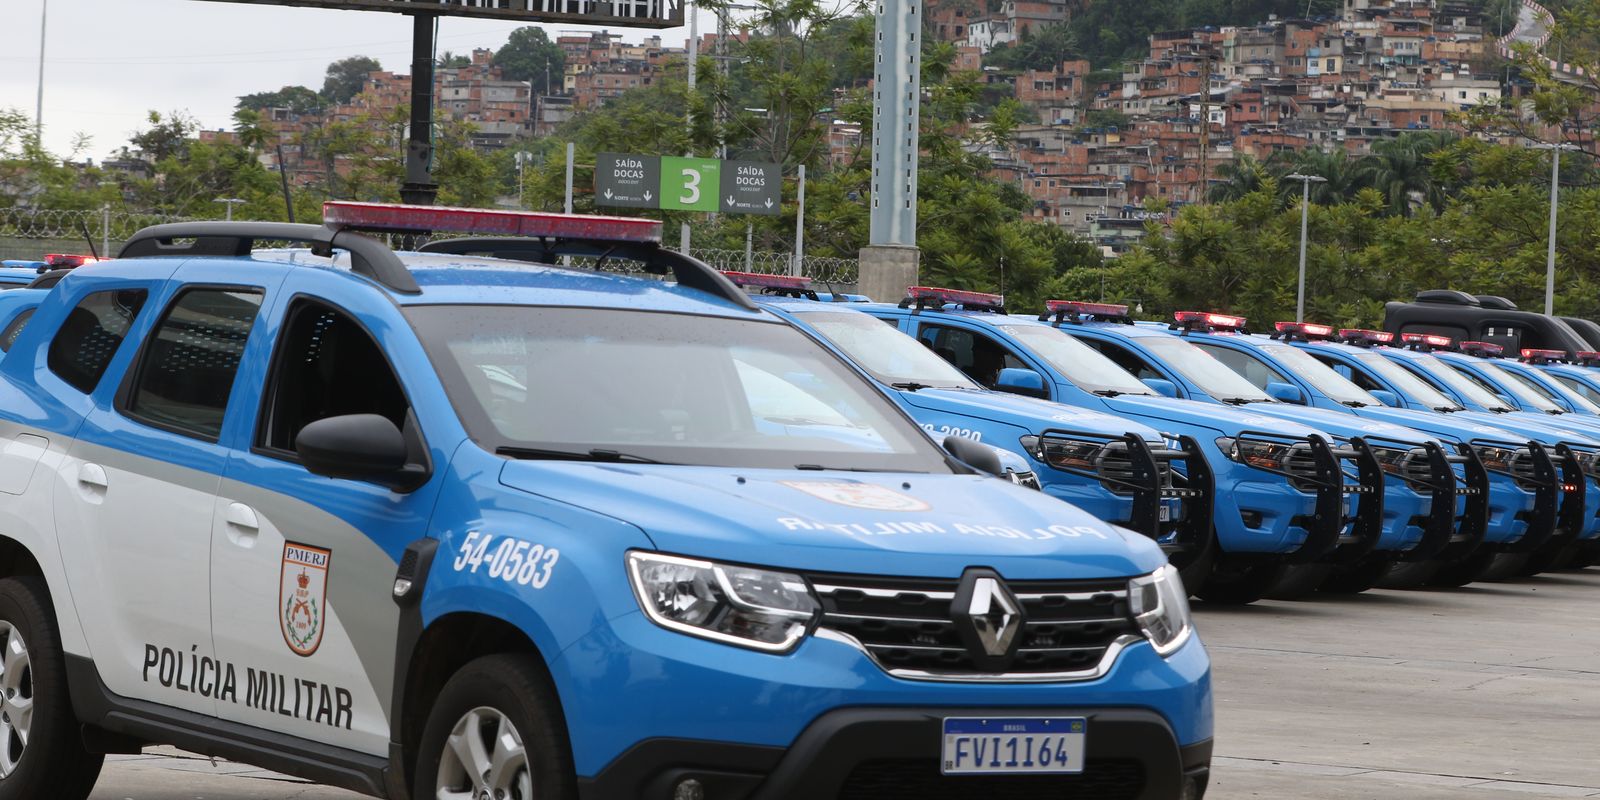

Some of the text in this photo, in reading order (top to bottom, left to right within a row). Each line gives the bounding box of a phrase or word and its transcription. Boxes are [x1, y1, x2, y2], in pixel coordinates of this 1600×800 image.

[615, 158, 643, 169] SAÍDA
[614, 169, 644, 179] DOCAS
[737, 166, 765, 177] SAÍDA
[680, 168, 701, 204] 3
[736, 176, 765, 187] DOCAS
[286, 547, 327, 567] PMERJ
[453, 531, 560, 590] 54-0583
[142, 643, 353, 731] POLÍCIA MILITAR
[1003, 724, 1027, 732] BRASIL
[955, 736, 1068, 768] FVI1I64
